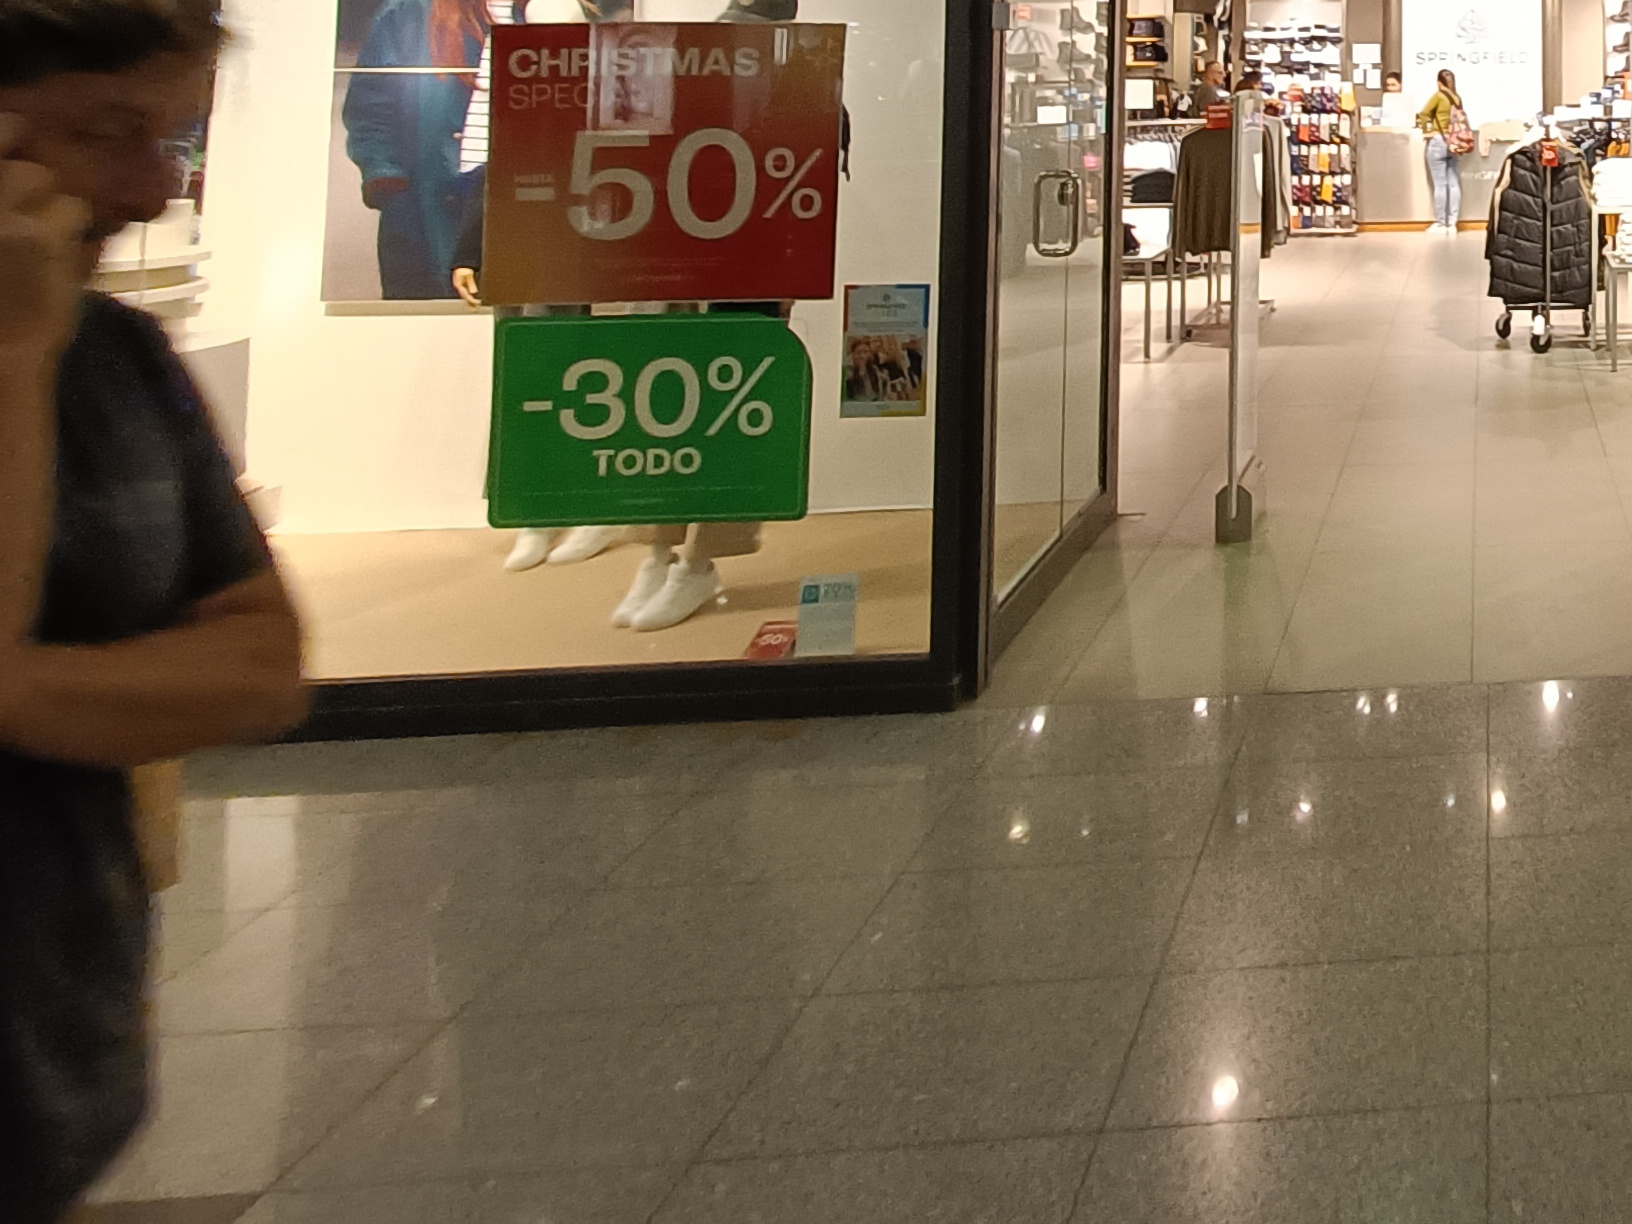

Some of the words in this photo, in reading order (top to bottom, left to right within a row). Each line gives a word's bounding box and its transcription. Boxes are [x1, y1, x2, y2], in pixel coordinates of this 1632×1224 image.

[508, 47, 760, 78] CHRISTMAS
[515, 128, 824, 241] -50%
[523, 356, 776, 440] -30%
[593, 447, 702, 476] TODO
